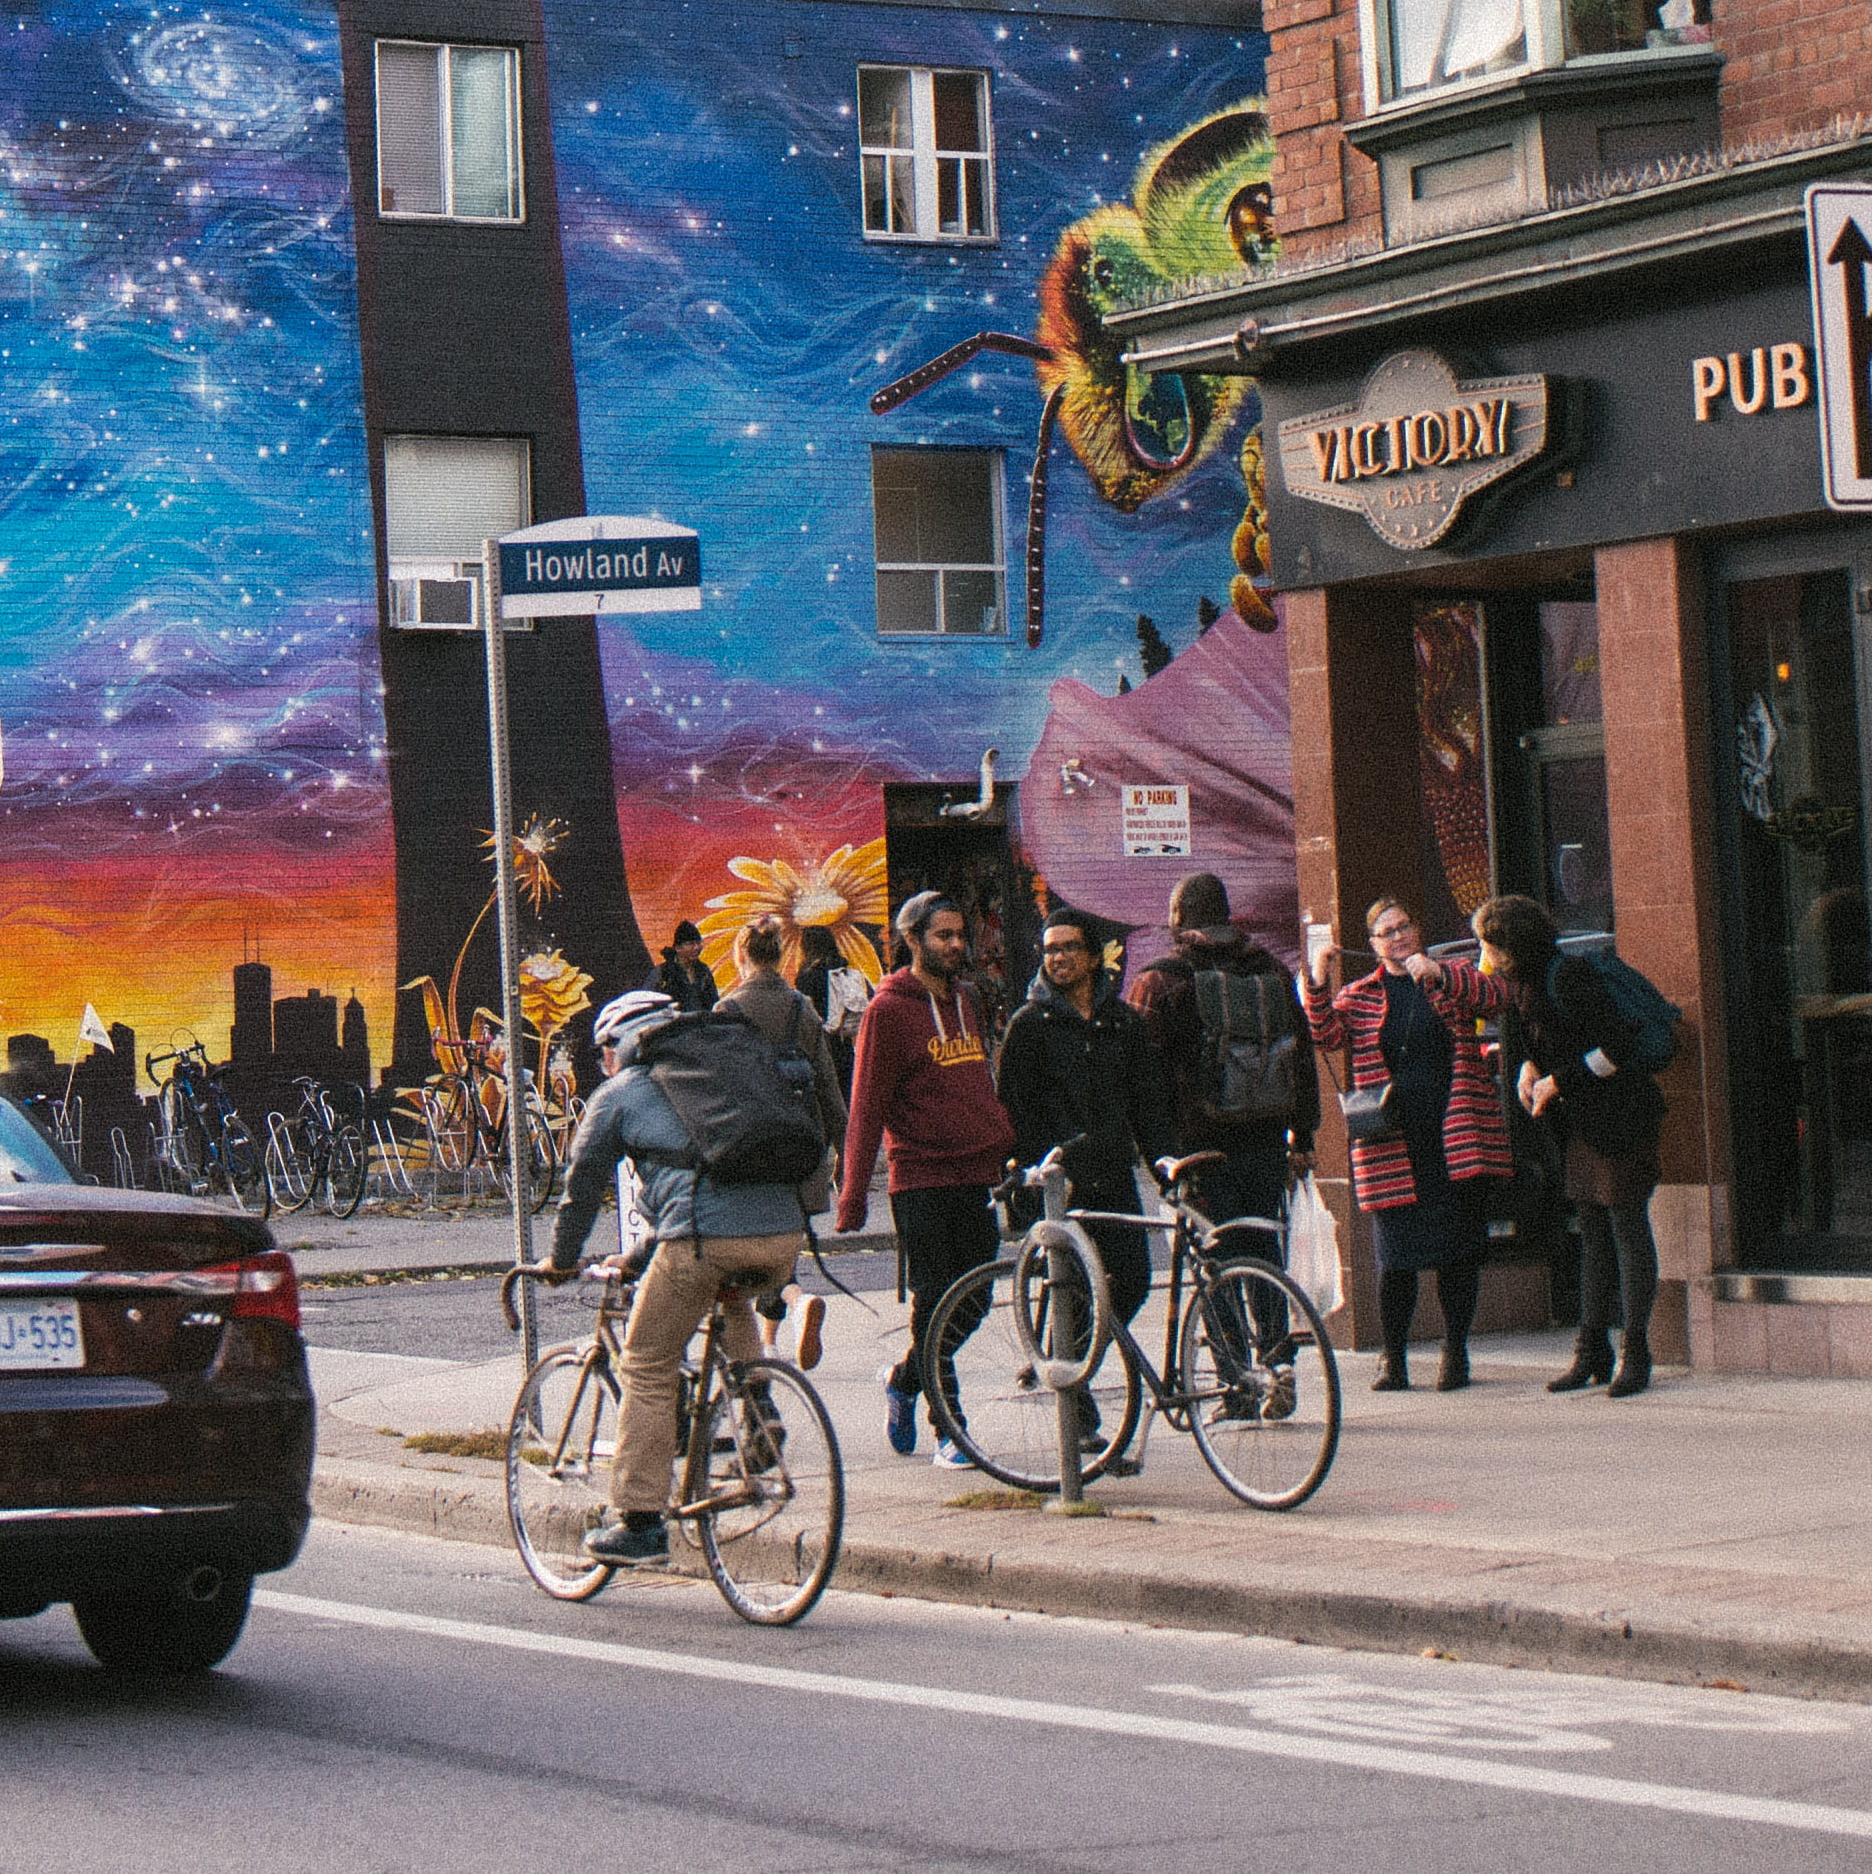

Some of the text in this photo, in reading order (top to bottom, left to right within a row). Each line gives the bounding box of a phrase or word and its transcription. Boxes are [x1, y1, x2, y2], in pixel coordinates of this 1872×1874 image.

[1691, 341, 1810, 423] PUB
[1308, 399, 1511, 484] VICTORY
[1385, 479, 1442, 510] CAFE
[525, 546, 684, 582] Howland Av
[593, 593, 605, 611] 7
[1133, 790, 1178, 806] NO PARKING
[624, 1161, 641, 1244] VICT
[29, 1315, 77, 1350] 535
